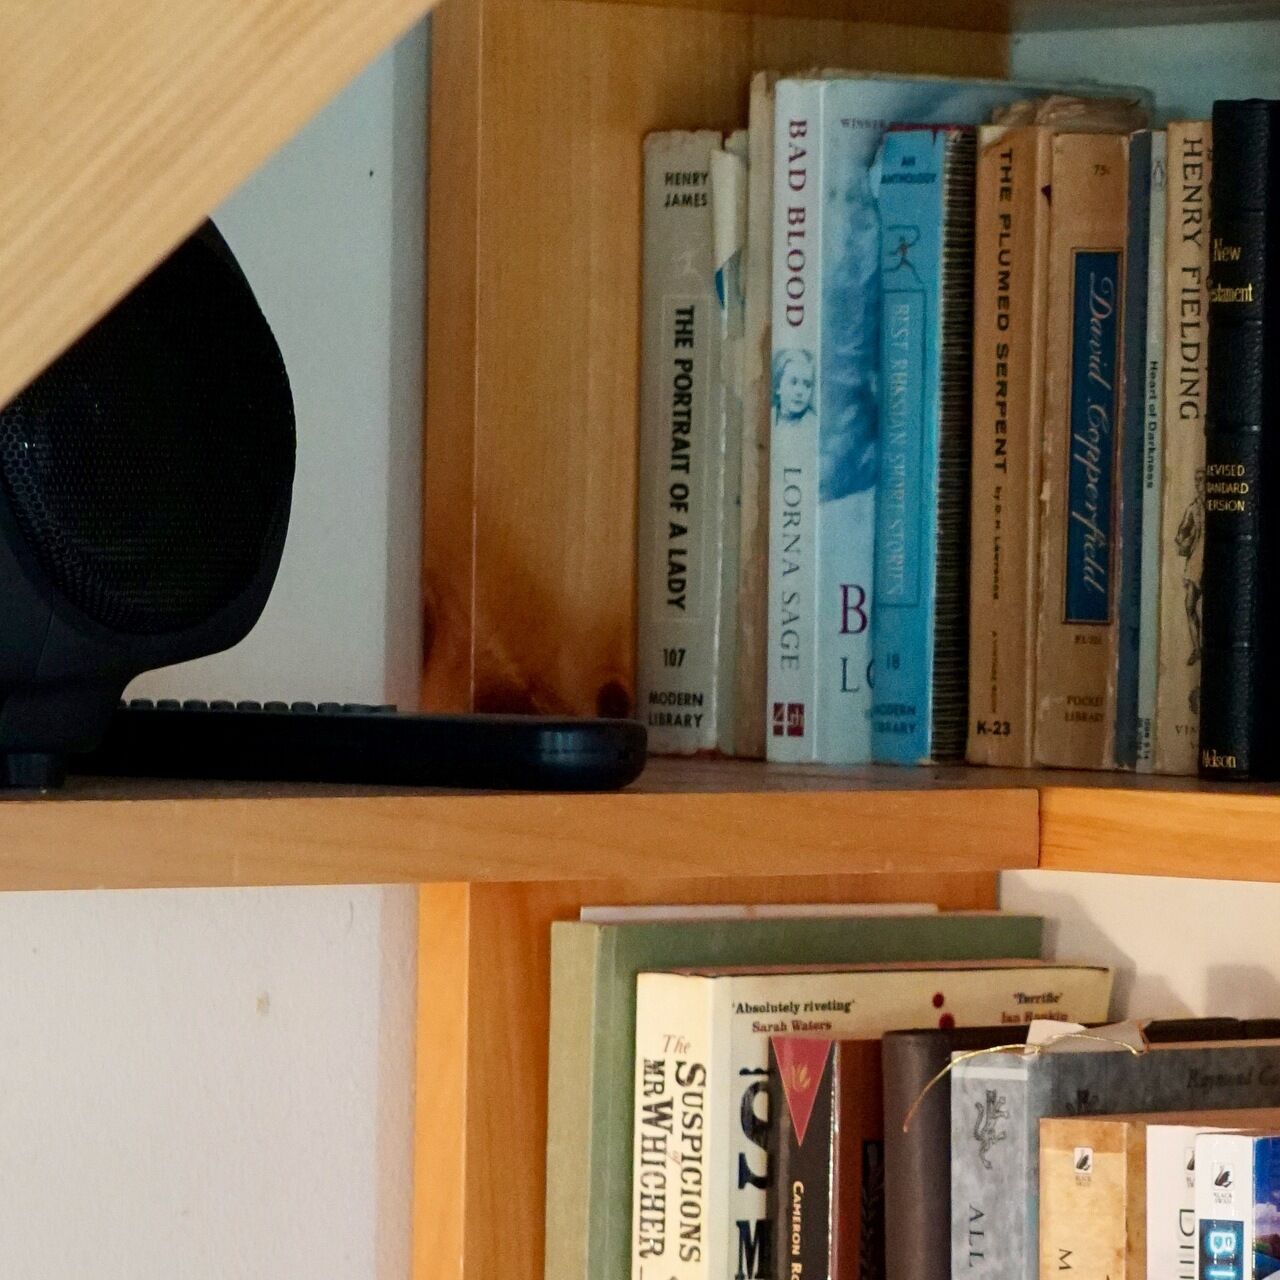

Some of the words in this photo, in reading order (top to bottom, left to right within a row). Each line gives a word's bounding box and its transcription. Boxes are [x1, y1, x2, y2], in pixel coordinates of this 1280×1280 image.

[787, 120, 807, 192] BAD
[999, 147, 1013, 203] THE
[1181, 138, 1203, 248] HENRY
[786, 206, 807, 327] BLOOD
[996, 212, 1012, 332] PLUMED
[673, 304, 695, 349] THE
[1086, 272, 1115, 391] David
[1179, 266, 1202, 420] FIELDING
[669, 358, 694, 475] PORTRAIT
[993, 343, 1010, 474] SERPENT
[667, 522, 688, 540] A
[668, 482, 691, 515] OF
[780, 467, 803, 578] LORNA
[1071, 397, 1113, 595] Copperfield
[665, 546, 688, 611] LADY
[662, 648, 686, 668] 107
[780, 591, 801, 672] SAGE
[977, 721, 1011, 735] K-23
[643, 1058, 666, 1097] MR
[639, 1096, 674, 1260] WHICHER
[674, 1059, 707, 1263] SUSPICIONS
[967, 1203, 985, 1269] ALL
